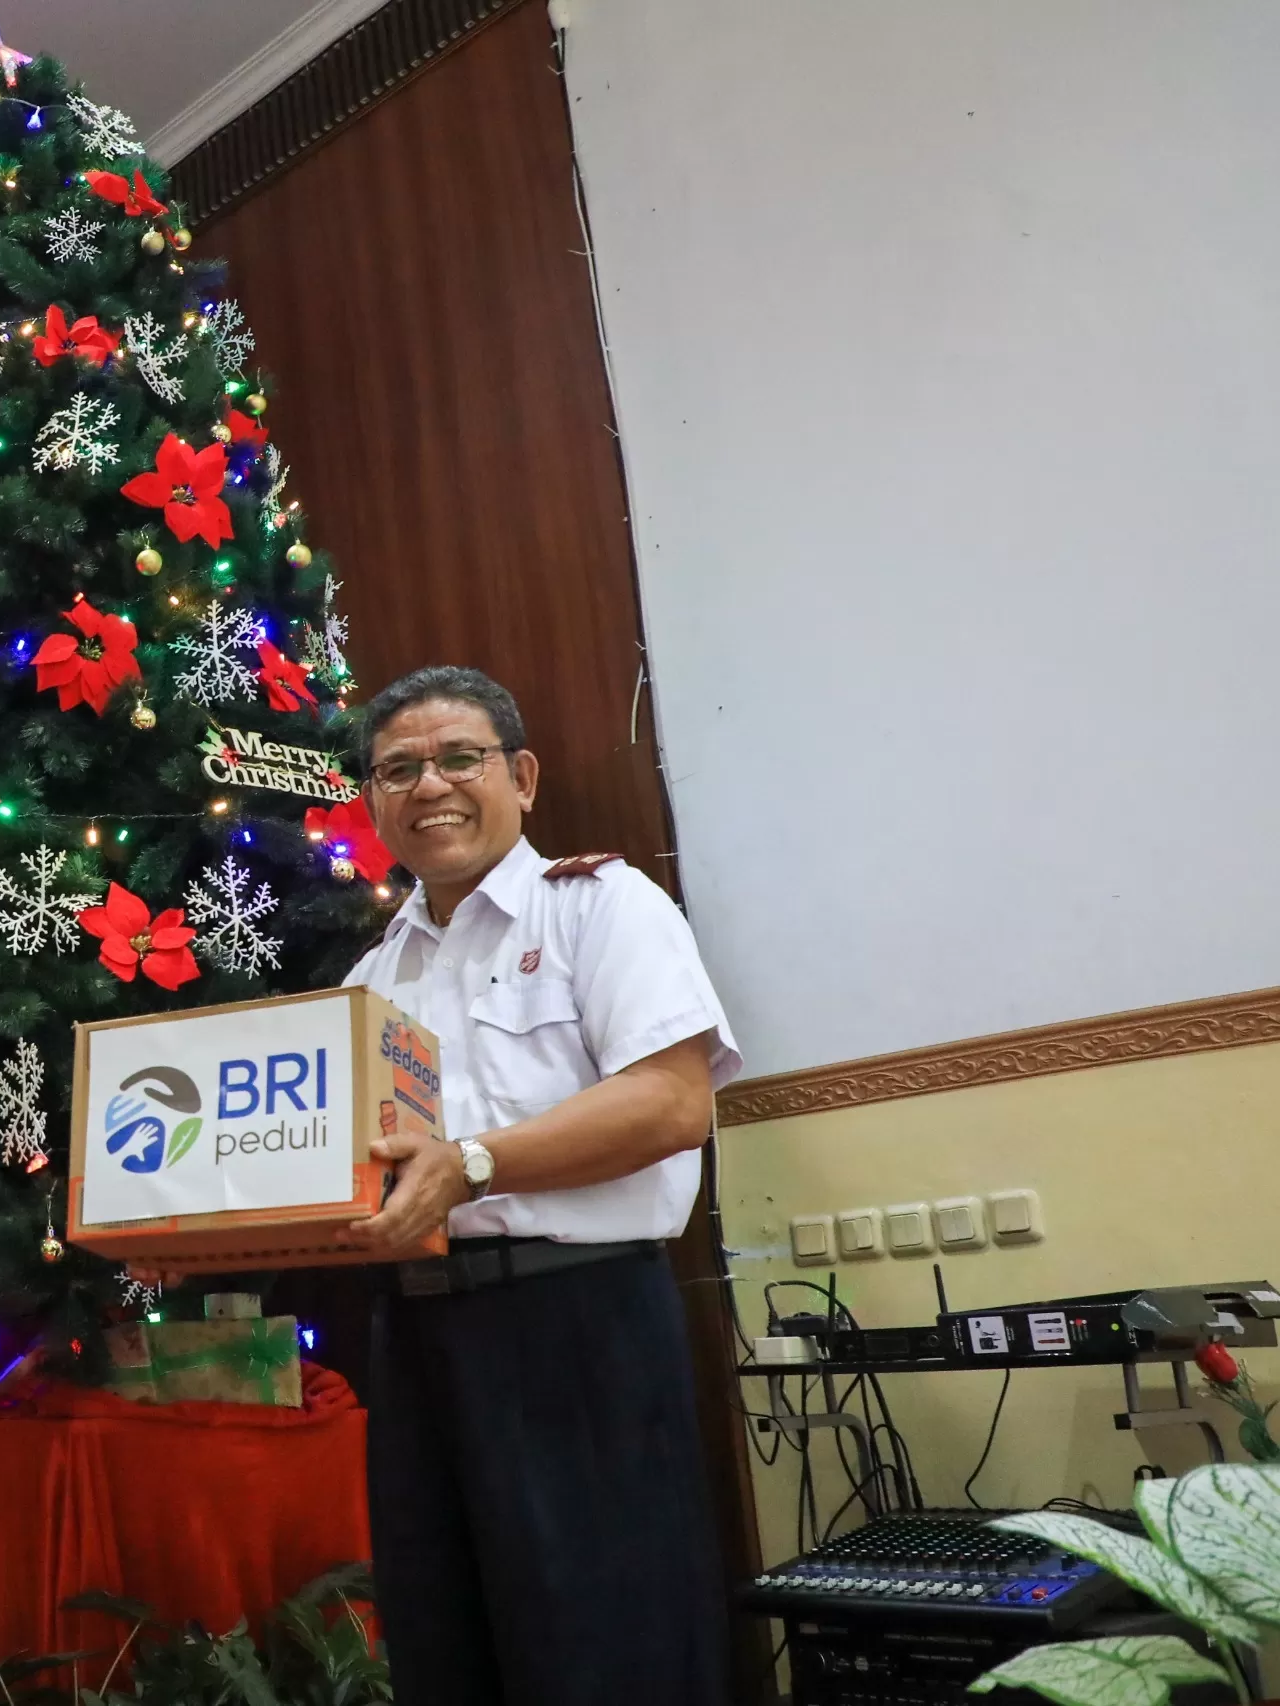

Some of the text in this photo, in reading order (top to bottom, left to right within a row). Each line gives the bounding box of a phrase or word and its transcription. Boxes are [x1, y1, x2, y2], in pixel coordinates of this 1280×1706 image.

[225, 727, 332, 776] Merry
[201, 755, 359, 804] Christmas
[217, 1048, 327, 1120] BRI
[380, 1031, 440, 1095] Sedaap
[215, 1116, 327, 1165] peduli
